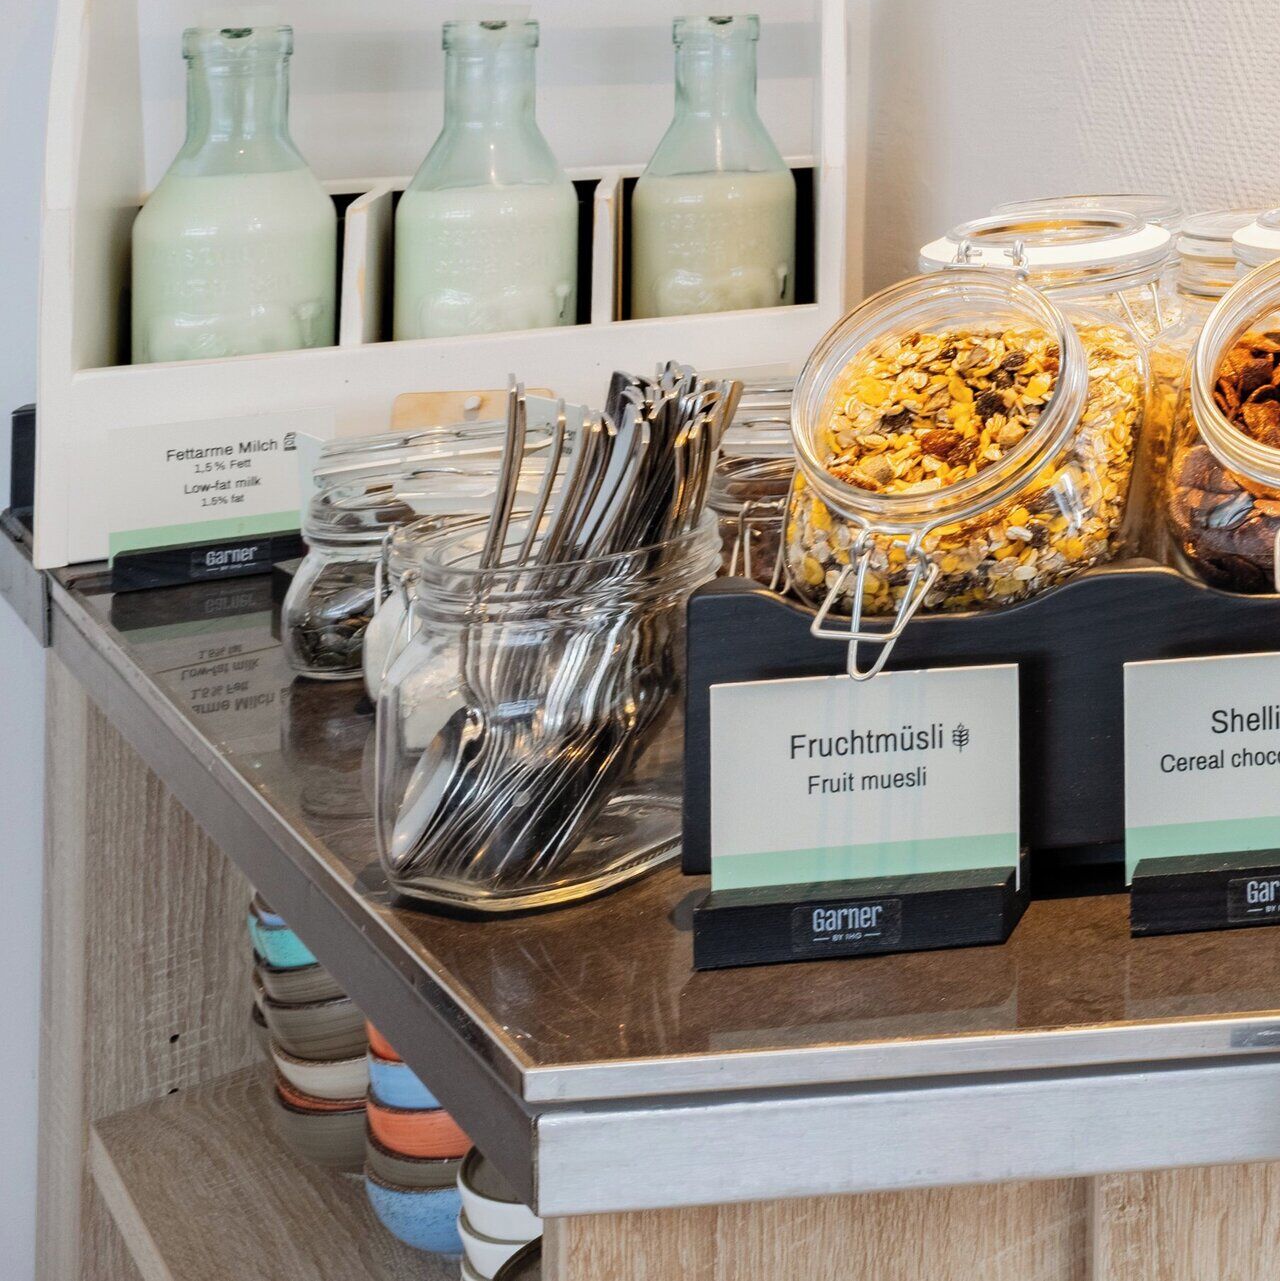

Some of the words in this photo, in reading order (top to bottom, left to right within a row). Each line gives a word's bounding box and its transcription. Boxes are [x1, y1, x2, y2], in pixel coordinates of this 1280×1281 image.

[166, 444, 234, 462] Fettarme
[238, 438, 278, 454] Milch
[230, 459, 252, 469] Fett
[184, 479, 231, 495] Low-fat
[236, 476, 262, 489] milk
[231, 493, 245, 504] fat
[205, 546, 259, 566] Garner
[790, 723, 943, 759] Fruchtmüsli
[1160, 749, 1224, 773] Cereal
[808, 772, 854, 794] Fruit
[861, 766, 927, 790] muesli
[812, 905, 883, 932] Garner
